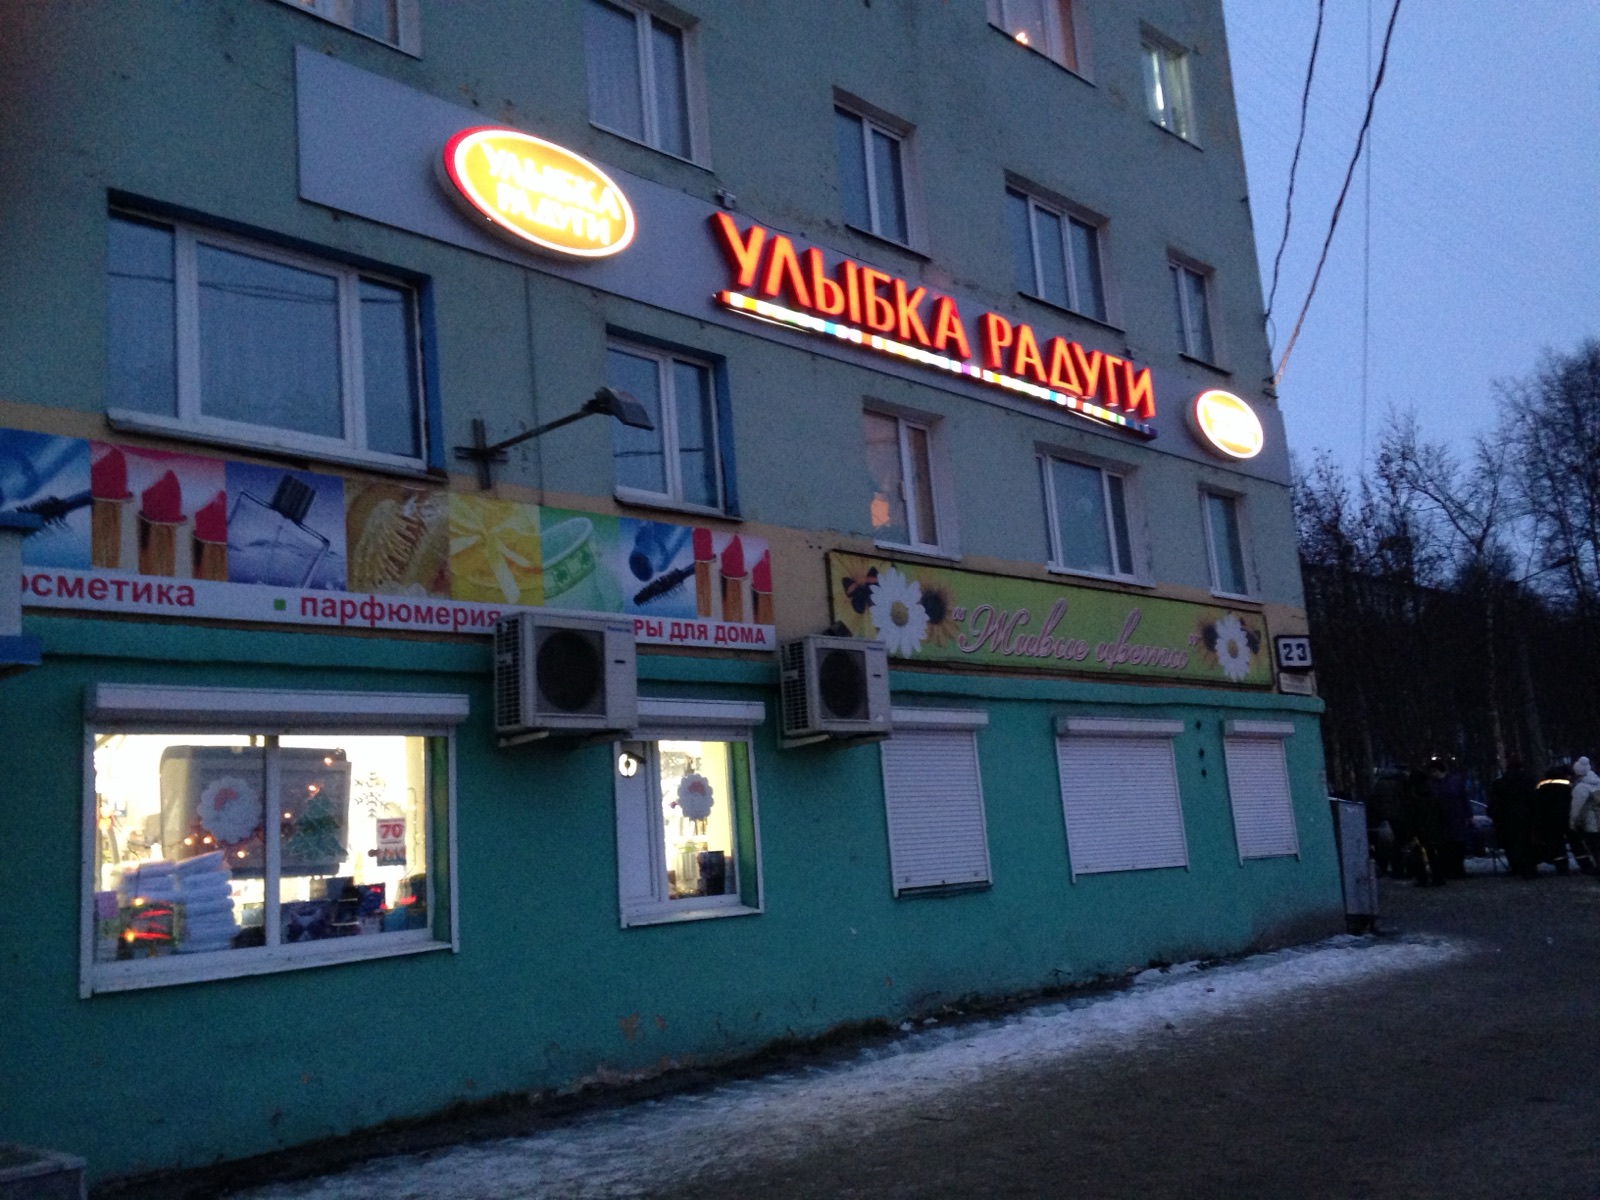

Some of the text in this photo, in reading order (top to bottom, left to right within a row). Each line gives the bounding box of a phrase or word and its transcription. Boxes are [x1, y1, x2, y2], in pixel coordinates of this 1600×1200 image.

[708, 211, 1156, 418] УЛЫБКА РАДУГИ
[300, 596, 501, 632] парфюмерия
[669, 622, 708, 642] ДЛЯ
[714, 625, 767, 645] ДОМА
[1282, 643, 1308, 661] 23
[380, 823, 403, 839] 70
